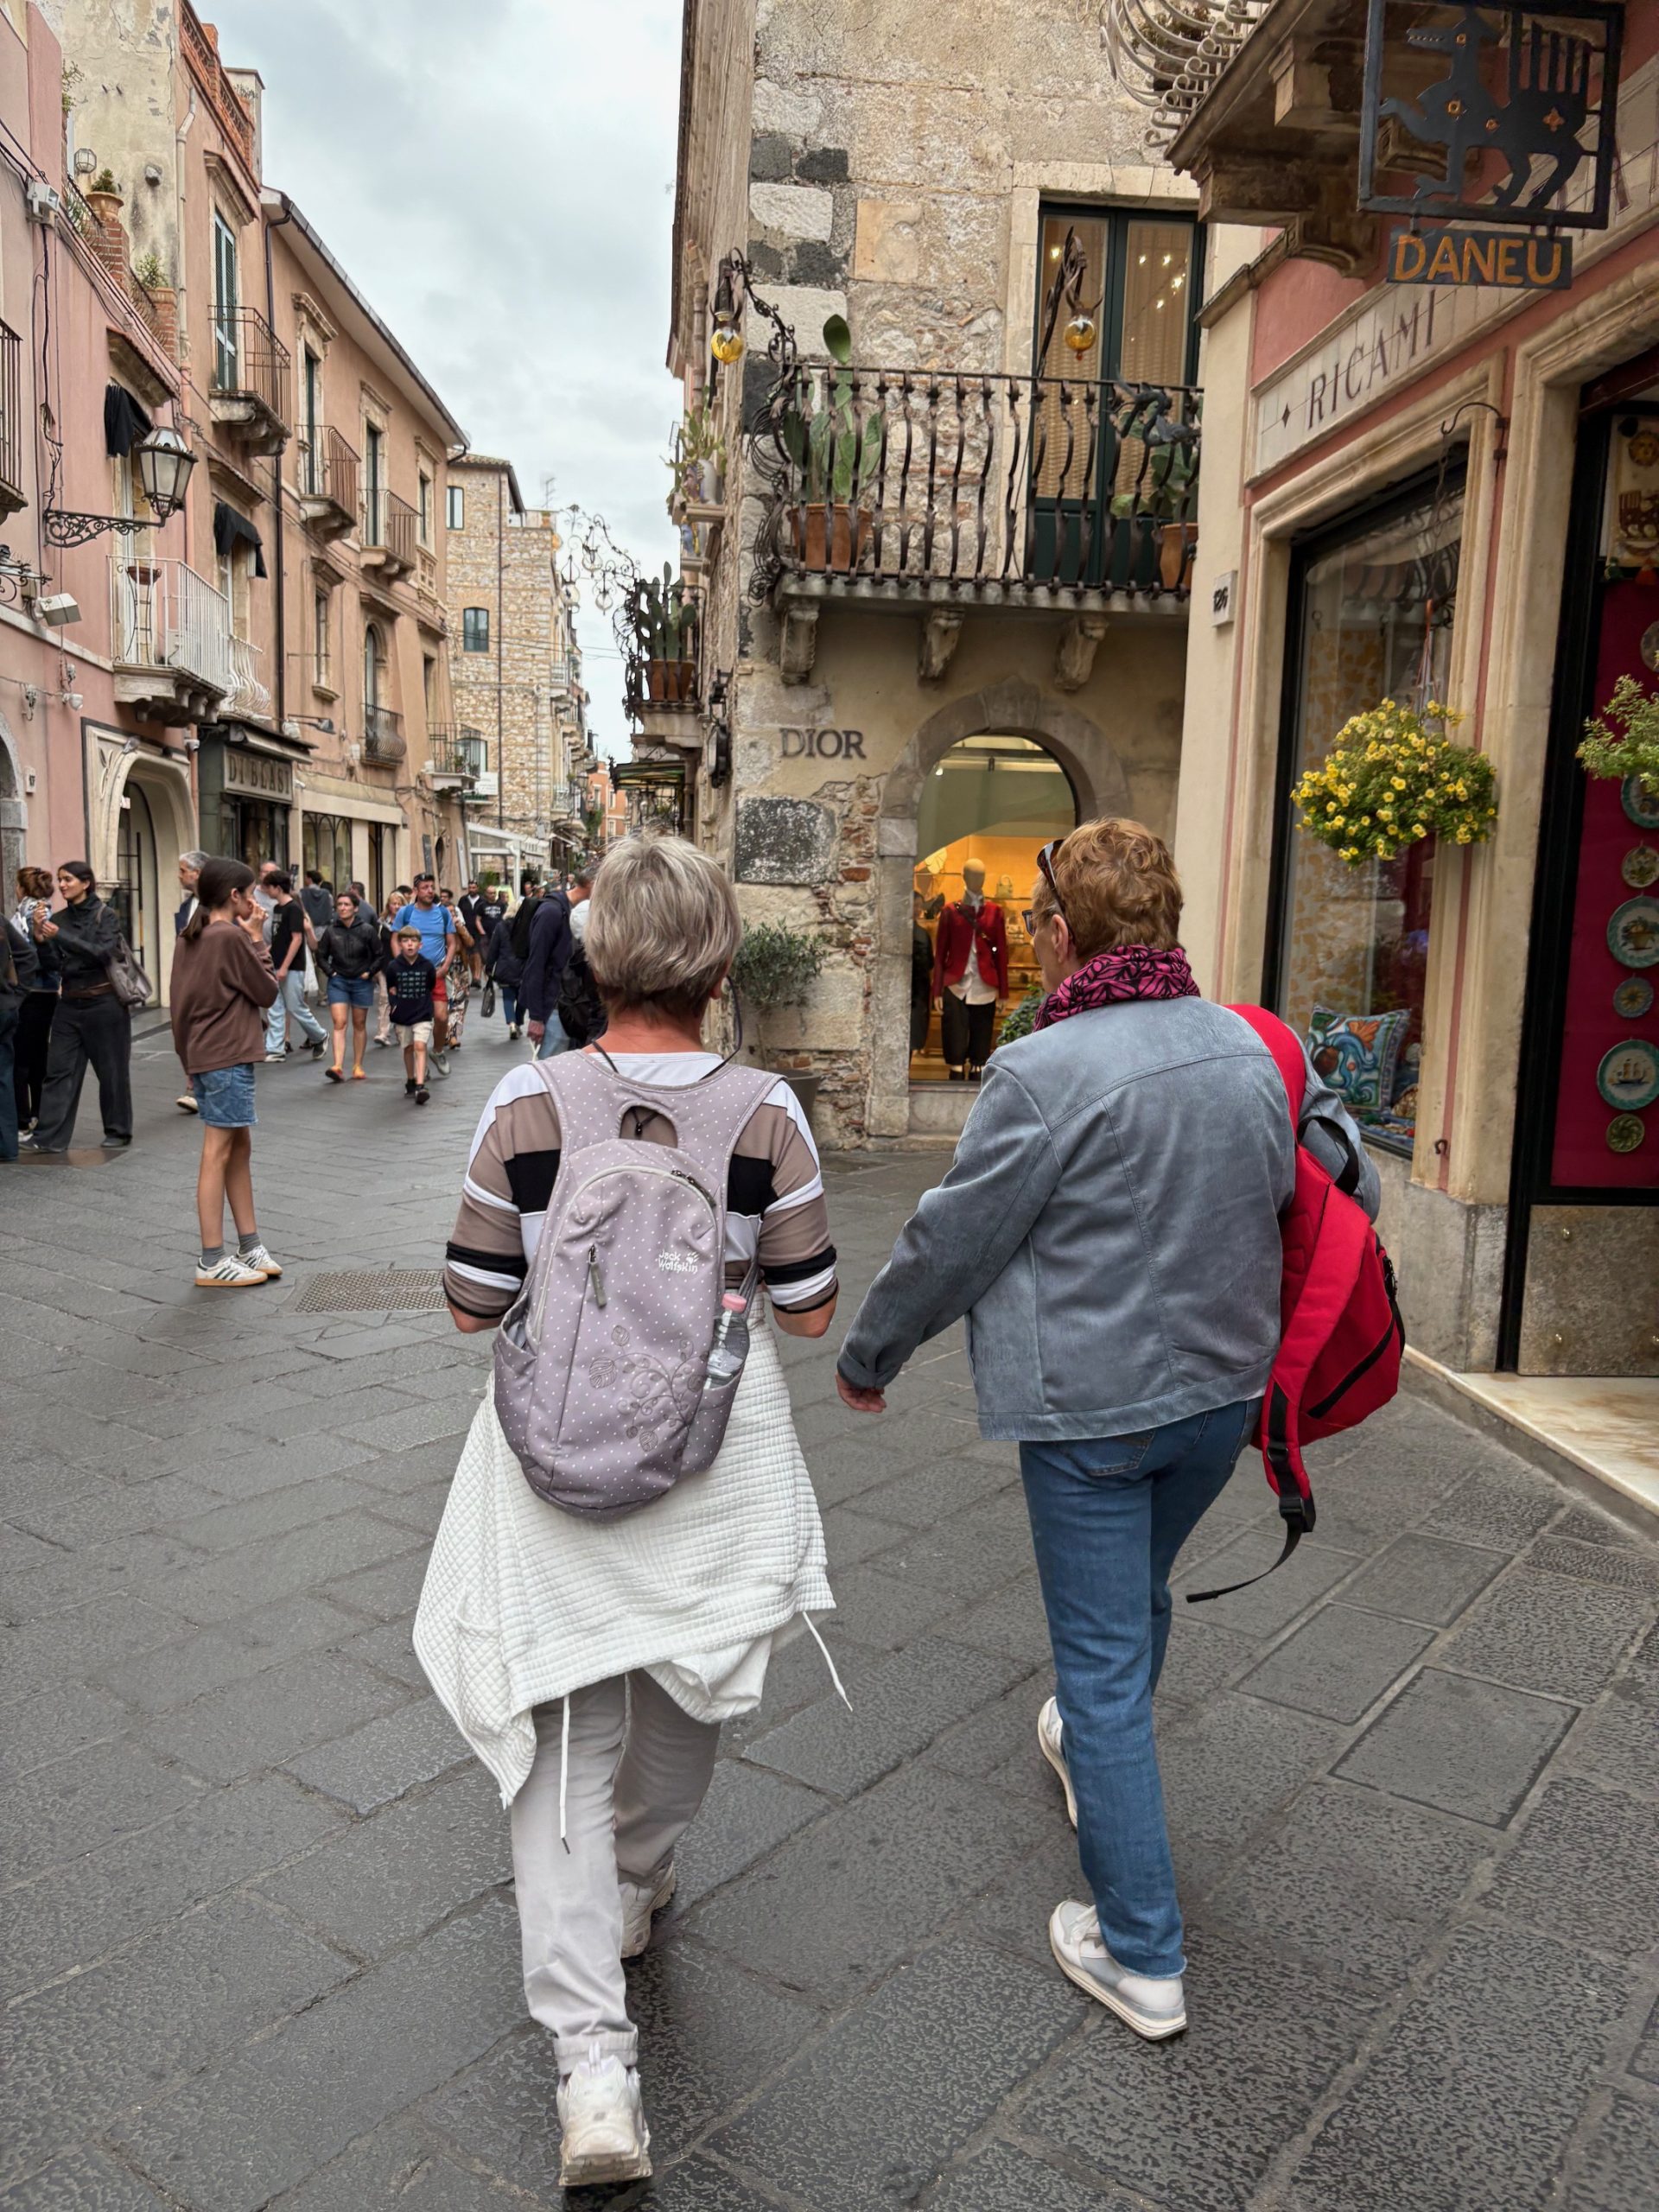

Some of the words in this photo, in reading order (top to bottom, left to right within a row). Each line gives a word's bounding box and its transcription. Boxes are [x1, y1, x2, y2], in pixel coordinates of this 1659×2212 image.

[1395, 234, 1562, 285] DANEU
[1307, 289, 1436, 430] RICAMI
[779, 728, 867, 759] DIOR
[658, 1249, 681, 1261] Jack
[658, 1258, 698, 1274] Wolfskin
